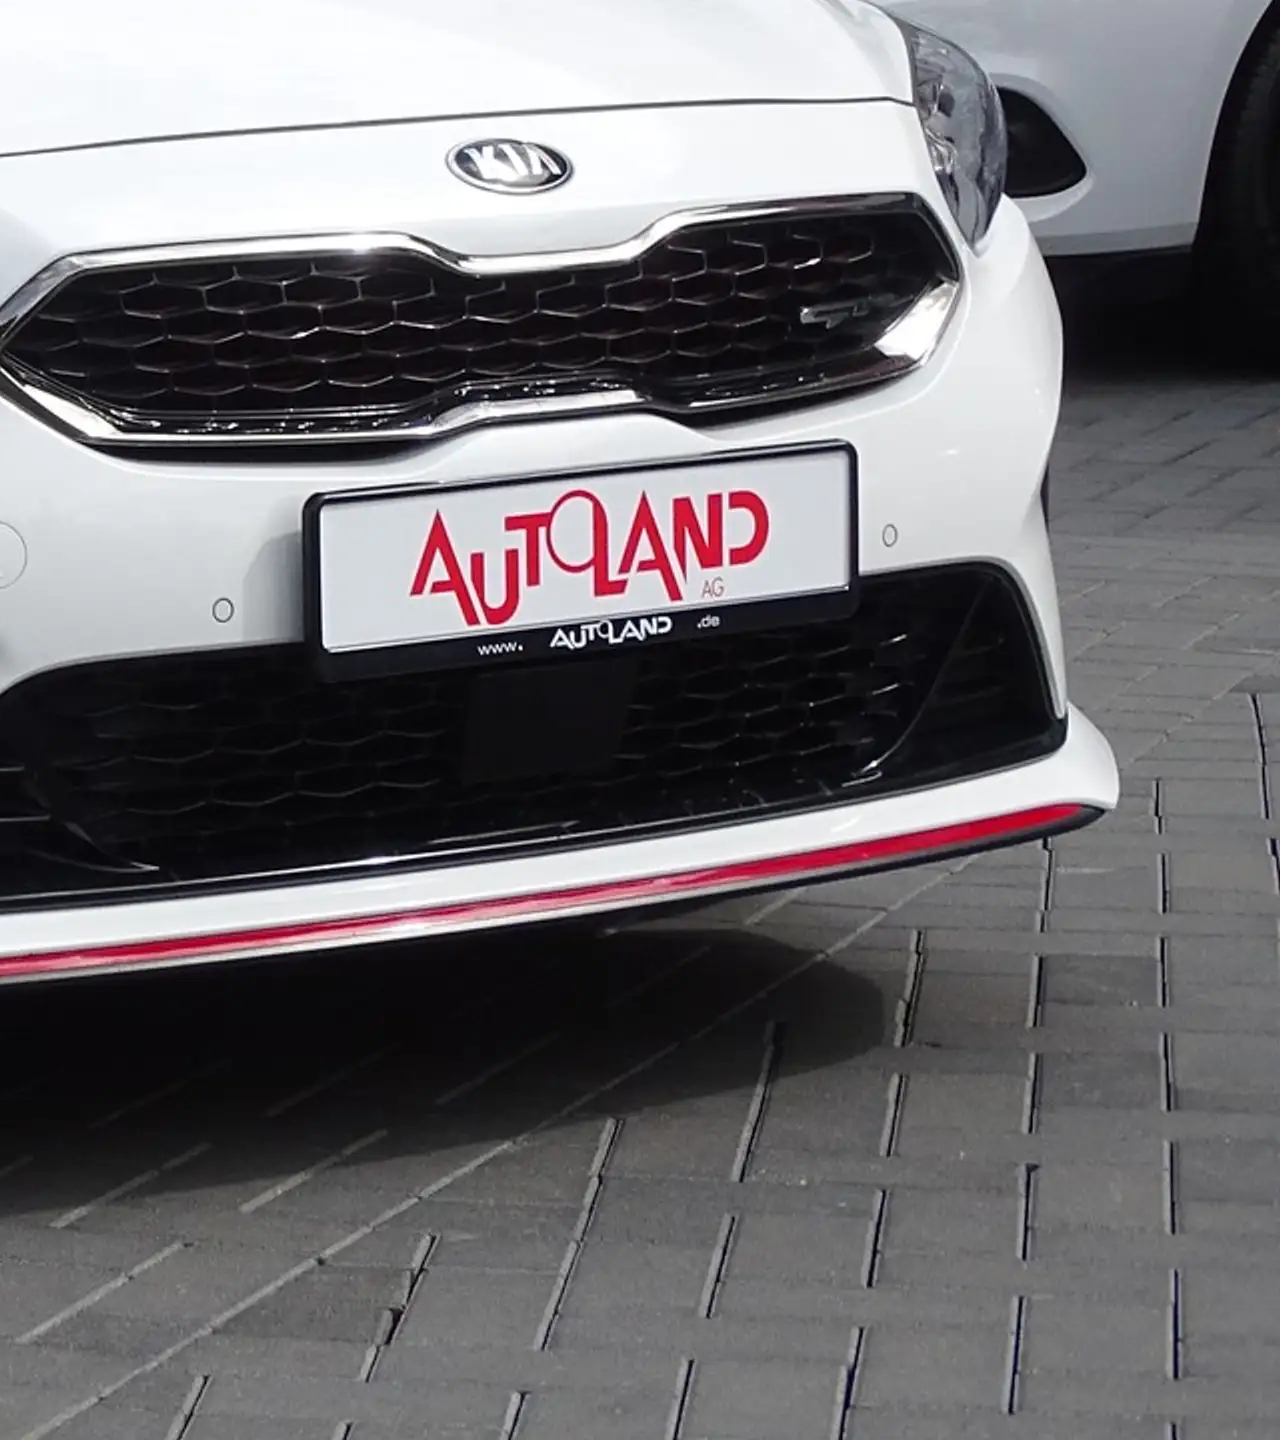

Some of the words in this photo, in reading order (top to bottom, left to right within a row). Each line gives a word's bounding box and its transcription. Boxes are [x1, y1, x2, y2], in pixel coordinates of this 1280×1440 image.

[462, 142, 562, 182] KIA
[409, 489, 771, 627] AUTOLAND
[701, 577, 726, 598] AG
